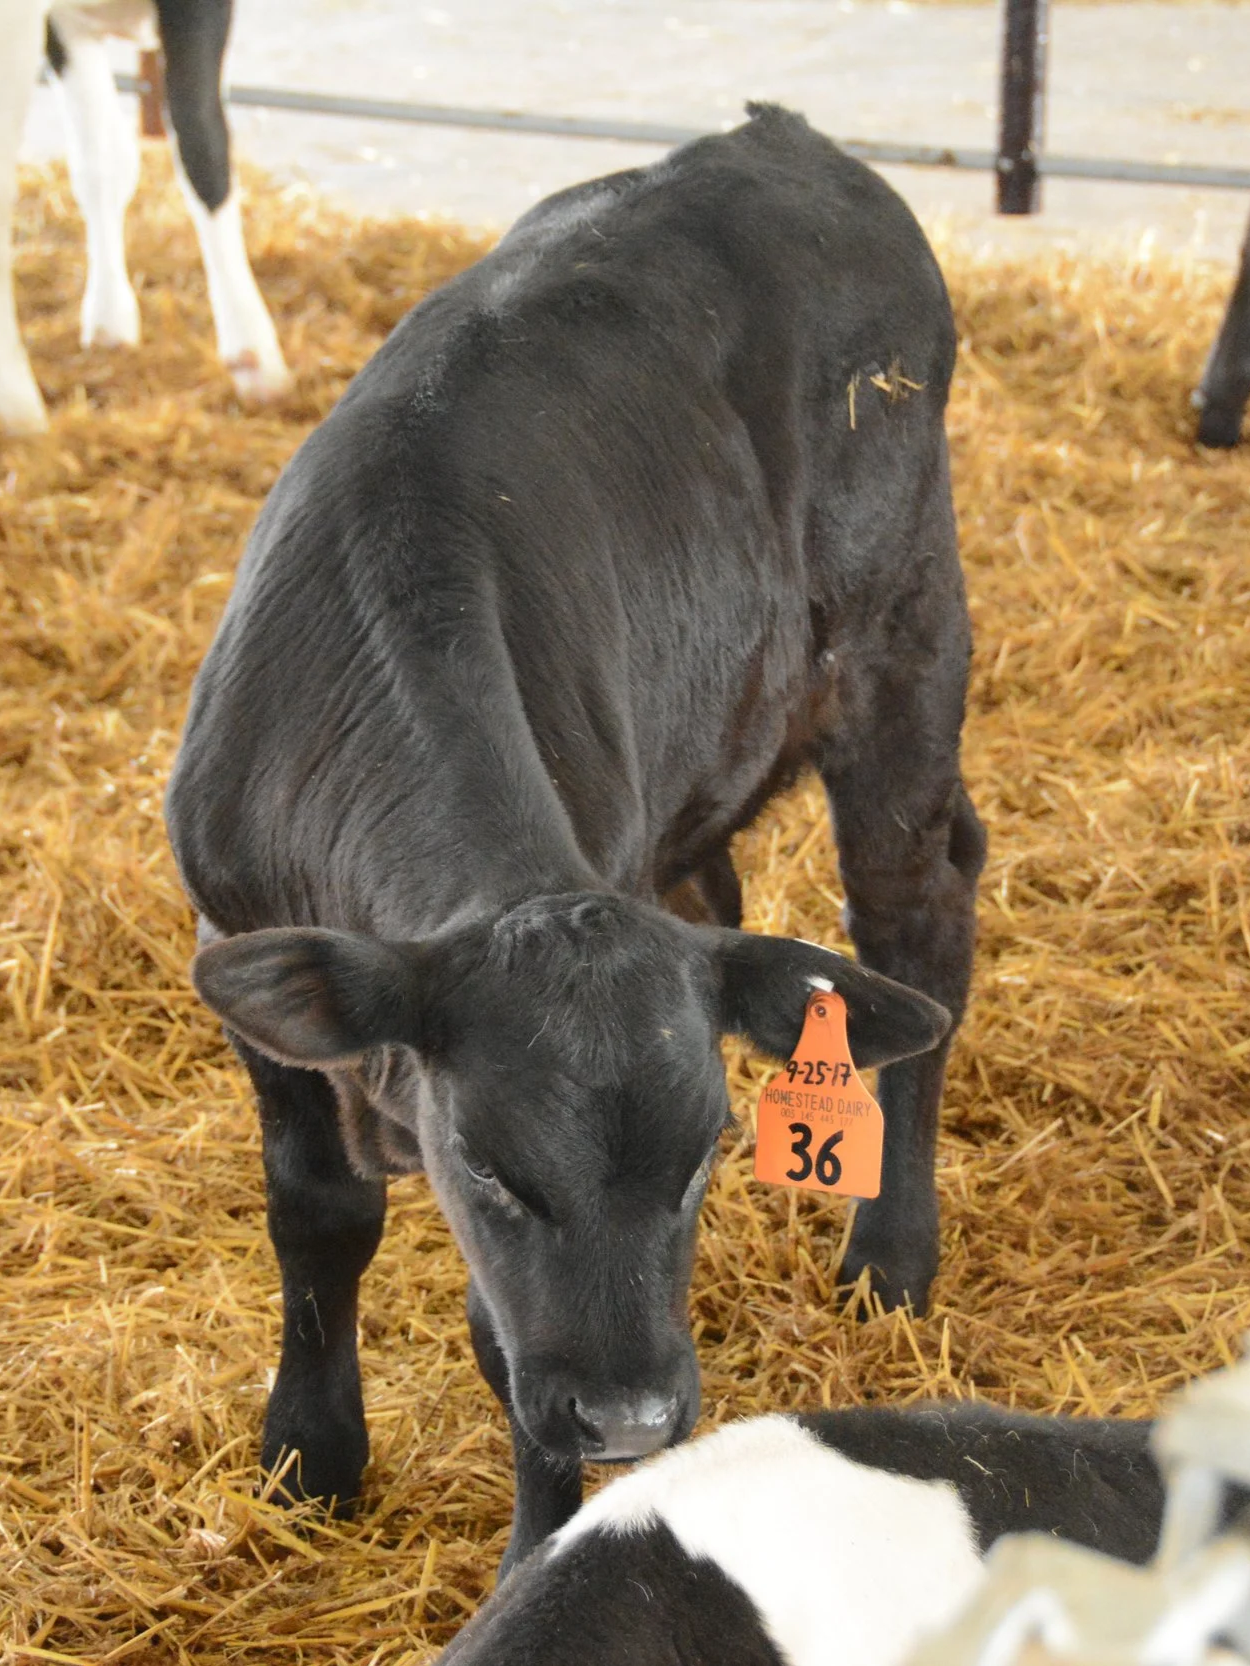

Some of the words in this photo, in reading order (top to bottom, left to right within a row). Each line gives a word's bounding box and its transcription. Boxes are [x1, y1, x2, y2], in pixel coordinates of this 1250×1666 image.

[786, 1060, 851, 1087] 9-25-17
[765, 1088, 834, 1113] HOMESTEAD
[837, 1099, 872, 1117] DAIRY
[786, 1122, 844, 1186] 36
